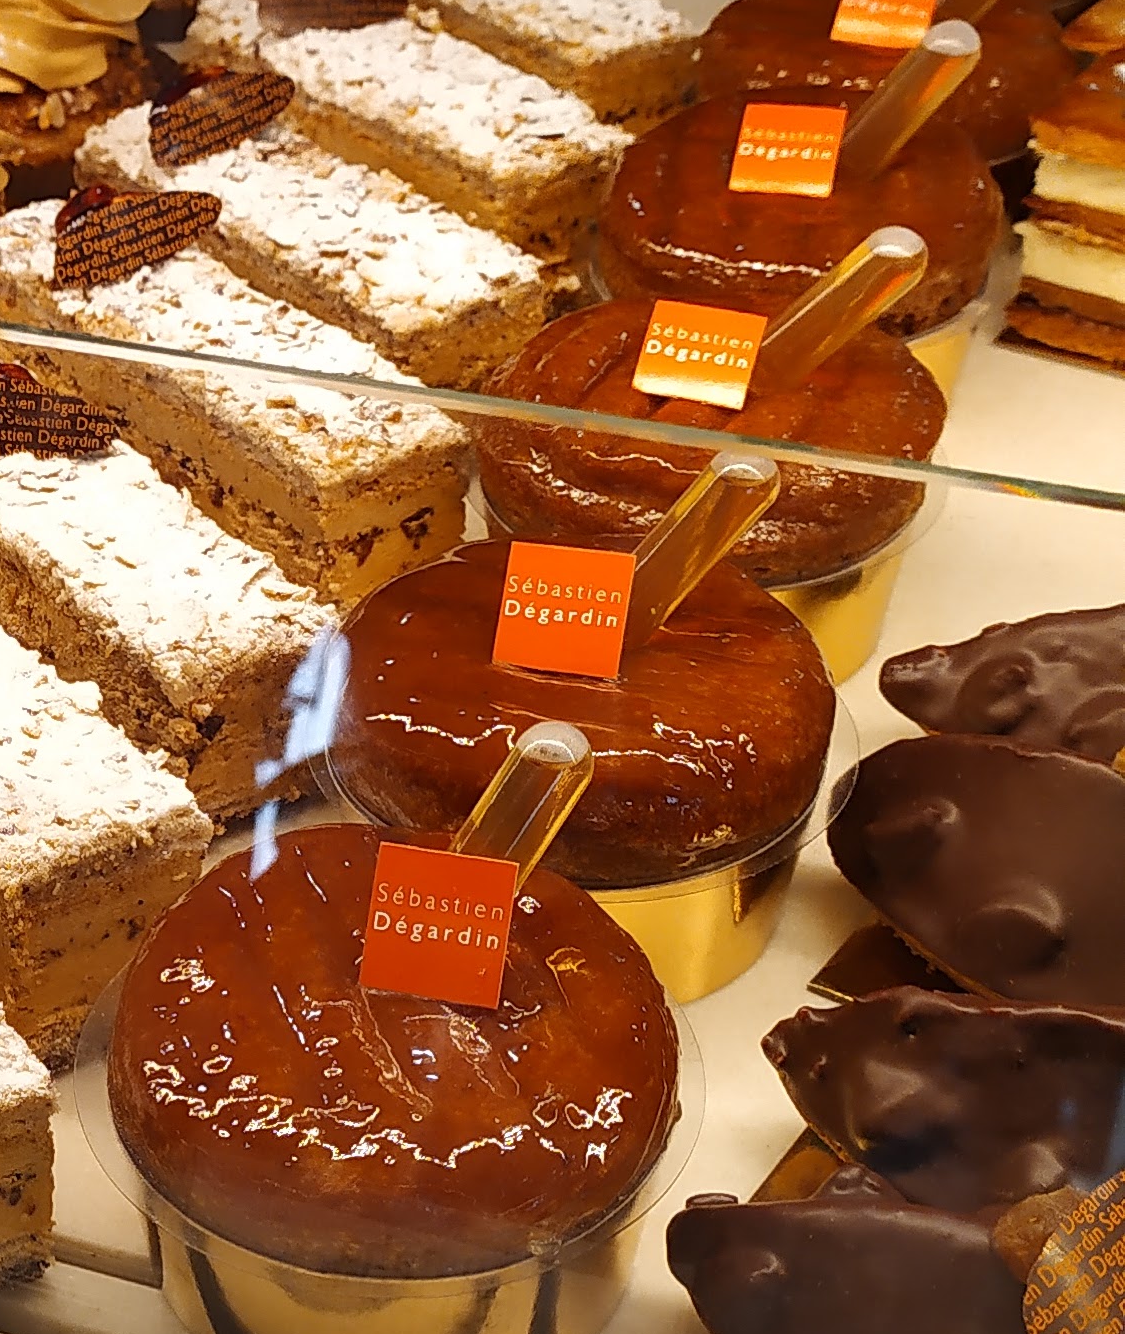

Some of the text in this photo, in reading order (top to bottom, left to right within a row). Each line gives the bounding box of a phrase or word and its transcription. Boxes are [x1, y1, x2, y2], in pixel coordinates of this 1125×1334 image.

[651, 322, 754, 351] Sébastien
[644, 339, 749, 370] Dégardin
[37, 429, 100, 450] Dégardin
[507, 575, 623, 605] Sébastien
[503, 599, 619, 628] Dégardin
[377, 882, 505, 923] Sébastien
[373, 911, 500, 951] Dégardin
